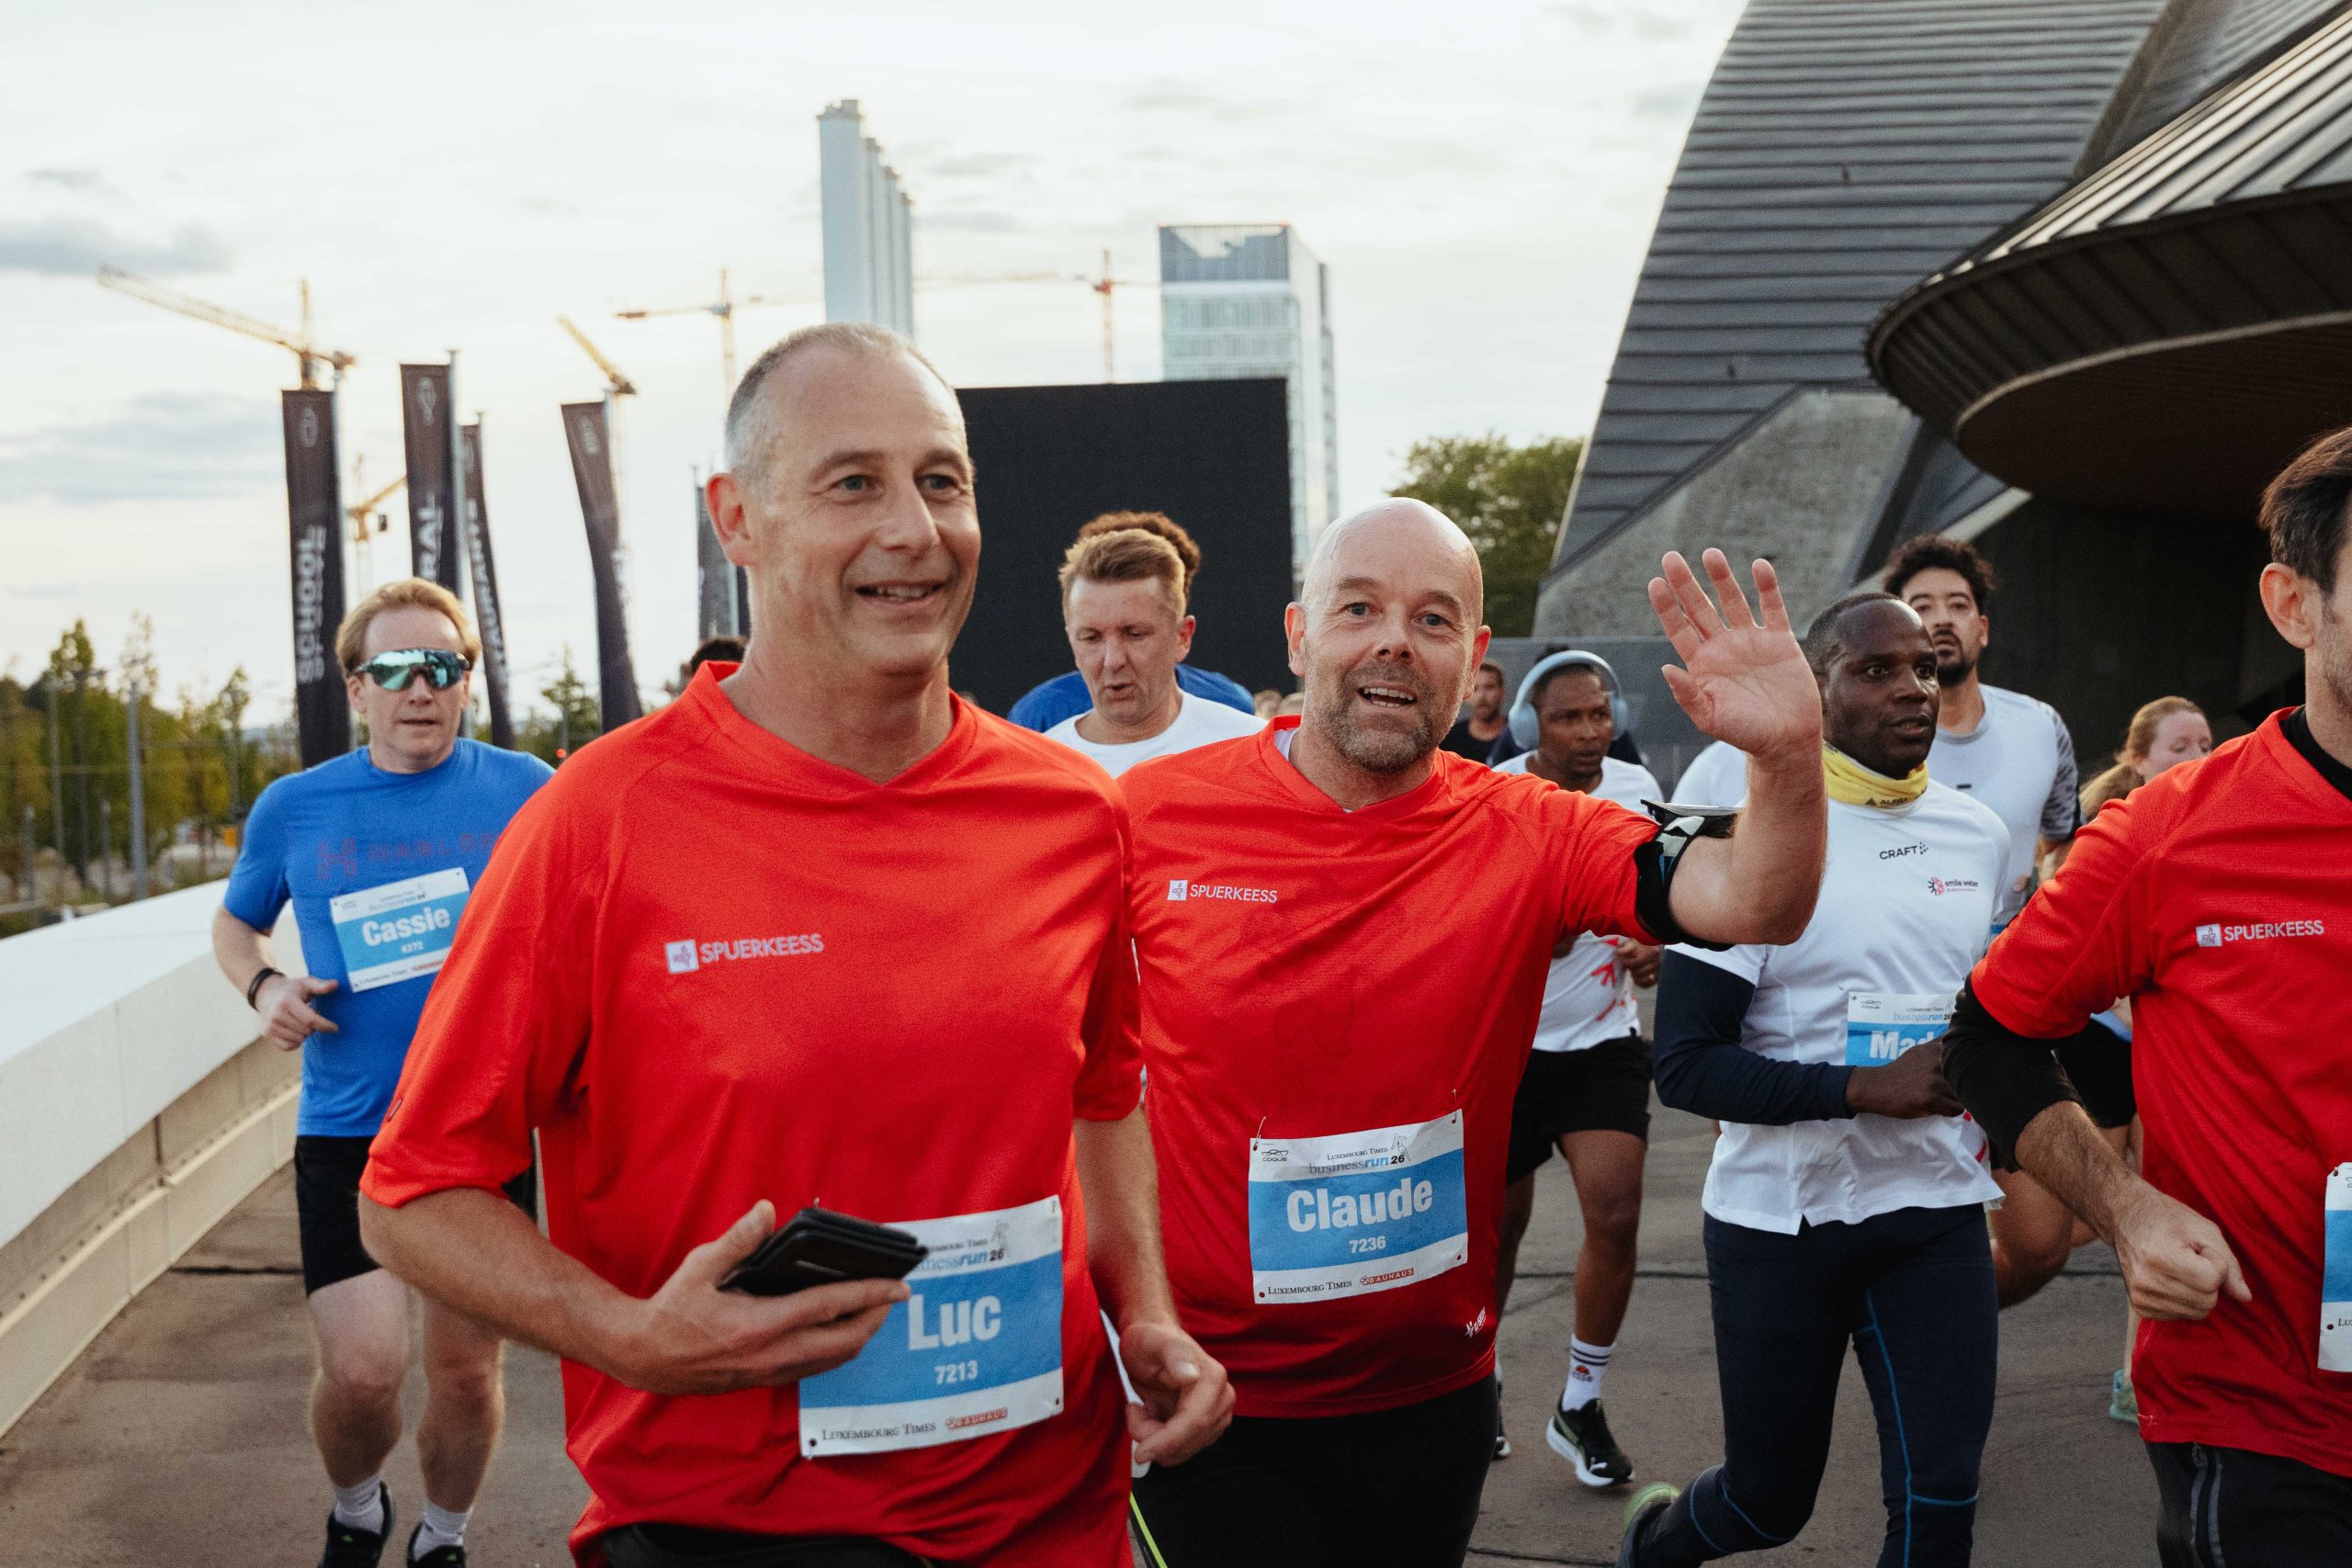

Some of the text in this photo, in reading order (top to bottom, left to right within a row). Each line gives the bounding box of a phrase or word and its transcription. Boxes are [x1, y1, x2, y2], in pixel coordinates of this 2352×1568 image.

[418, 490, 444, 581] RAL
[296, 524, 326, 684] SCHOOL
[1879, 846, 1917, 860] CRAFT
[1190, 884, 1278, 903] SPUERKEESS
[362, 907, 451, 946] Cassie
[2223, 919, 2324, 942] SPUERKEESS
[699, 933, 824, 964] SPUERKEESS
[1390, 1155, 1406, 1165] 26
[1286, 1177, 1432, 1232] Claude
[989, 1248, 1005, 1261] 26
[1349, 1235, 1386, 1254] 7236
[1368, 1268, 1414, 1283] BAUHAUS
[908, 1294, 1001, 1351] Luc
[934, 1359, 978, 1385] 7213
[956, 1408, 1008, 1427] BAUHAUS
